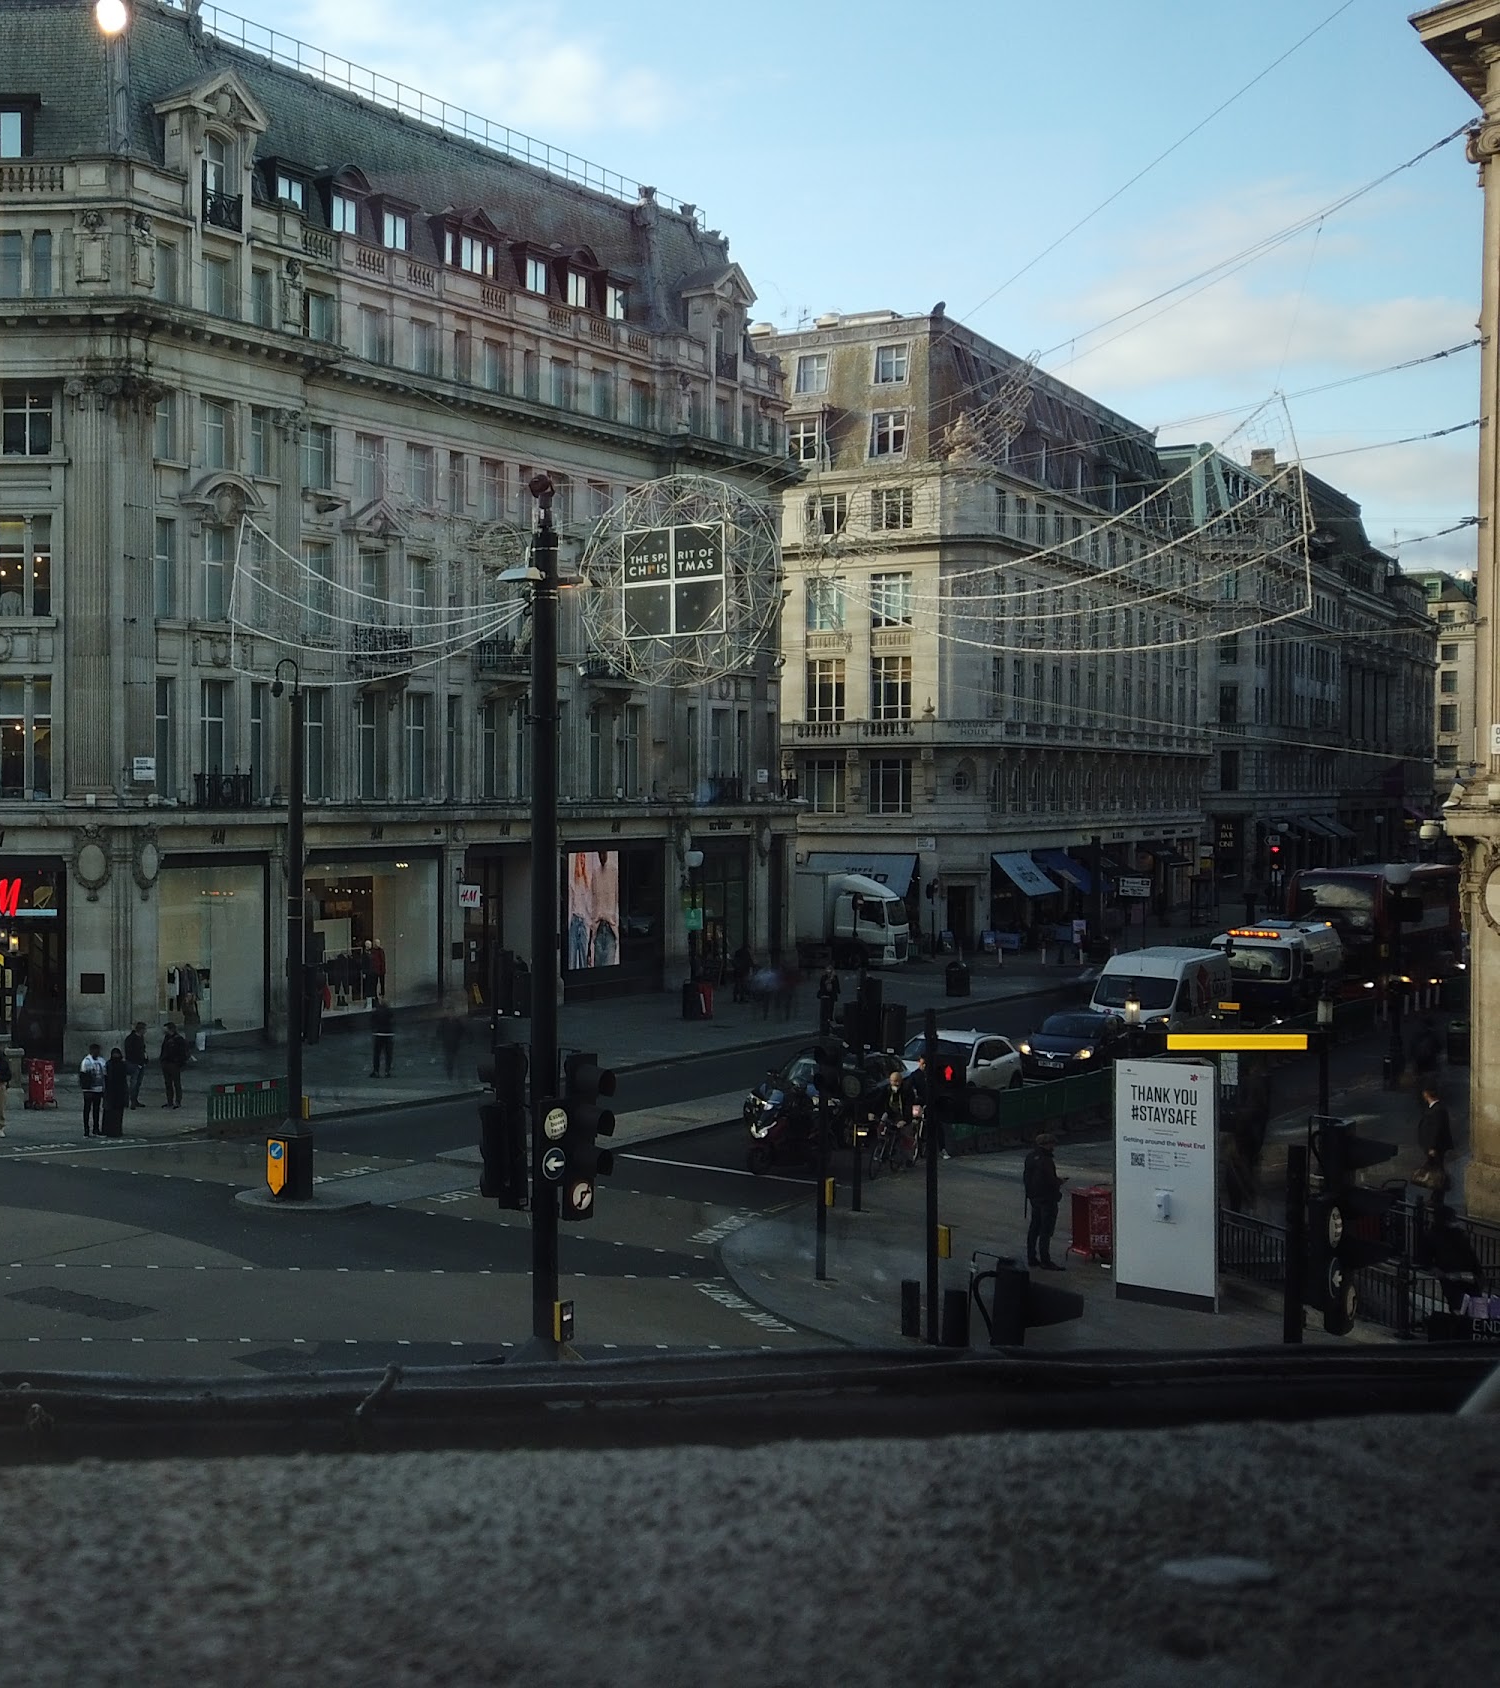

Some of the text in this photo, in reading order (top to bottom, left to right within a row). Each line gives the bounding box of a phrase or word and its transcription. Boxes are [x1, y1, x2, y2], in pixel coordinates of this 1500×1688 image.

[630, 554, 649, 565] THE
[698, 547, 714, 557] OF
[461, 889, 478, 902] H&M
[1130, 1084, 1198, 1106] THANK YOU
[1131, 1104, 1198, 1127] #STAYSAFE
[1123, 1136, 1144, 1145] Getting
[1177, 1141, 1193, 1149] West
[1090, 1234, 1110, 1244] FREE
